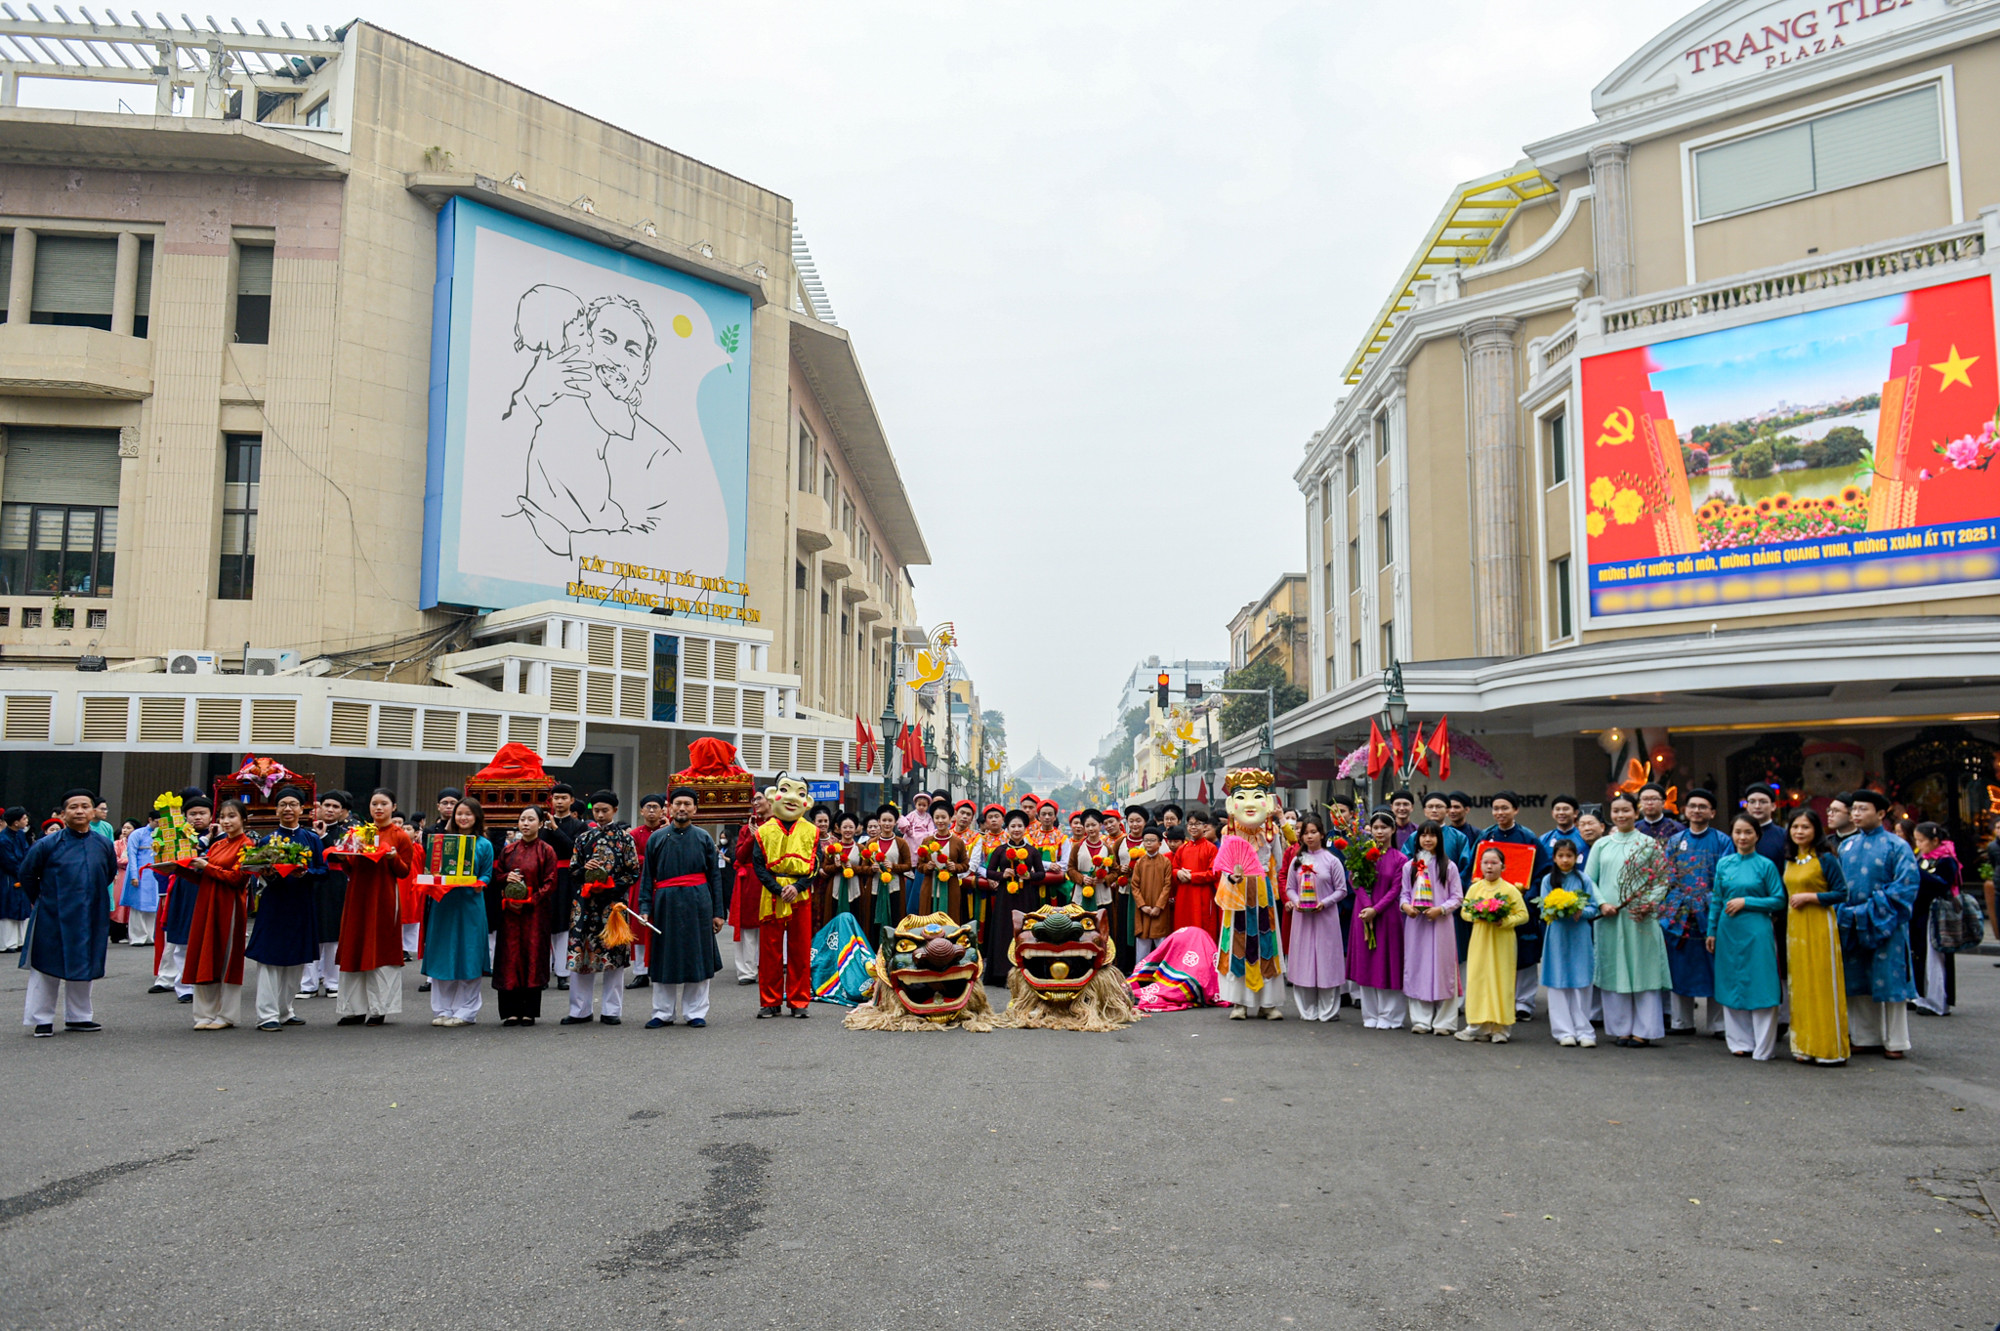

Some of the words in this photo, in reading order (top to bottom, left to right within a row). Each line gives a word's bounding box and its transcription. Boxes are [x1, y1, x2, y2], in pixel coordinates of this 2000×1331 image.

[1685, 10, 1819, 74] TRANG
[1765, 34, 1845, 69] PLAZA
[1598, 566, 1627, 582] MỪNG
[1628, 562, 1646, 579] ĐẤT
[1648, 560, 1675, 576] NƯỚC
[1676, 556, 1693, 574] ĐỔI
[1719, 552, 1751, 569] MỪNG
[1752, 547, 1781, 566] ĐẢNG
[1783, 546, 1820, 563] QUANG
[1821, 542, 1852, 558] VINH,
[1853, 537, 1888, 555] MỪNG
[1889, 533, 1922, 551] XUÂN
[1924, 528, 1939, 547] ẤT
[1941, 530, 1956, 547] TỴ
[1958, 527, 1988, 543] 2025
[1990, 525, 1996, 539] !
[652, 568, 671, 585] LẠI
[675, 569, 697, 587] ĐẤT
[738, 582, 751, 597] TA
[695, 601, 709, 615] TO
[713, 604, 733, 621] ĐẸP
